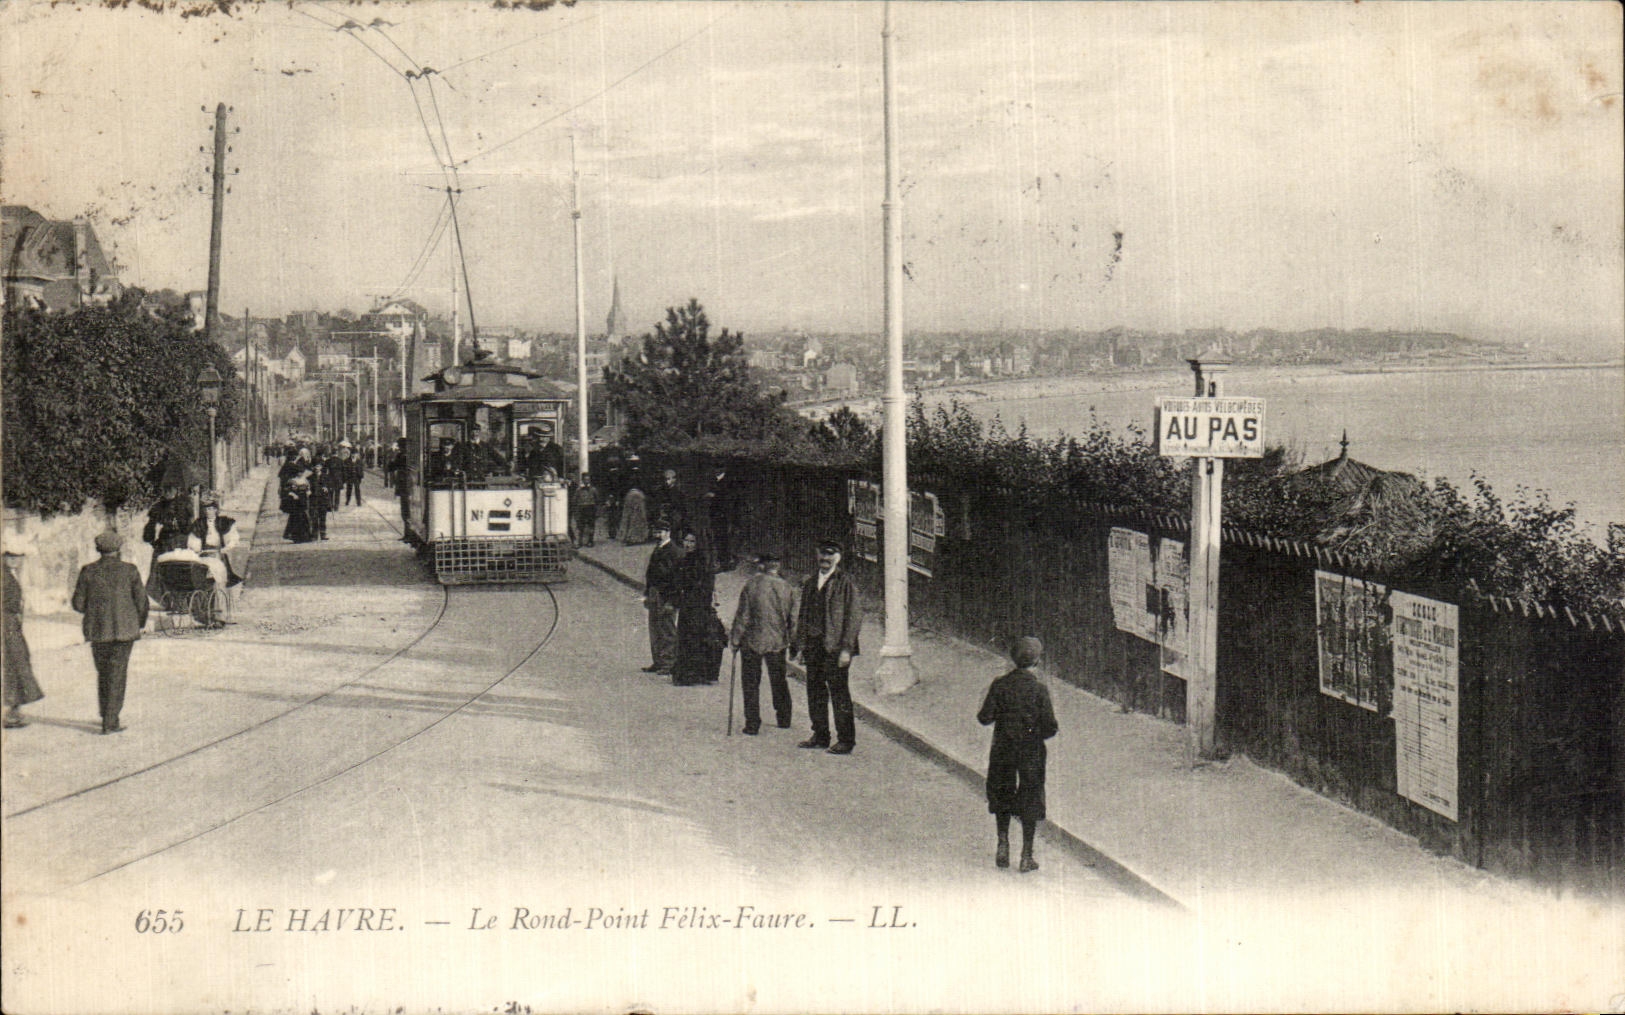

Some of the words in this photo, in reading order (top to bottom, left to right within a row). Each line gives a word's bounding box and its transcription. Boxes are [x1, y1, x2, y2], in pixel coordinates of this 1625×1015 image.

[1167, 416, 1198, 440] AU
[1208, 417, 1257, 441] PAS
[515, 509, 532, 521] 45
